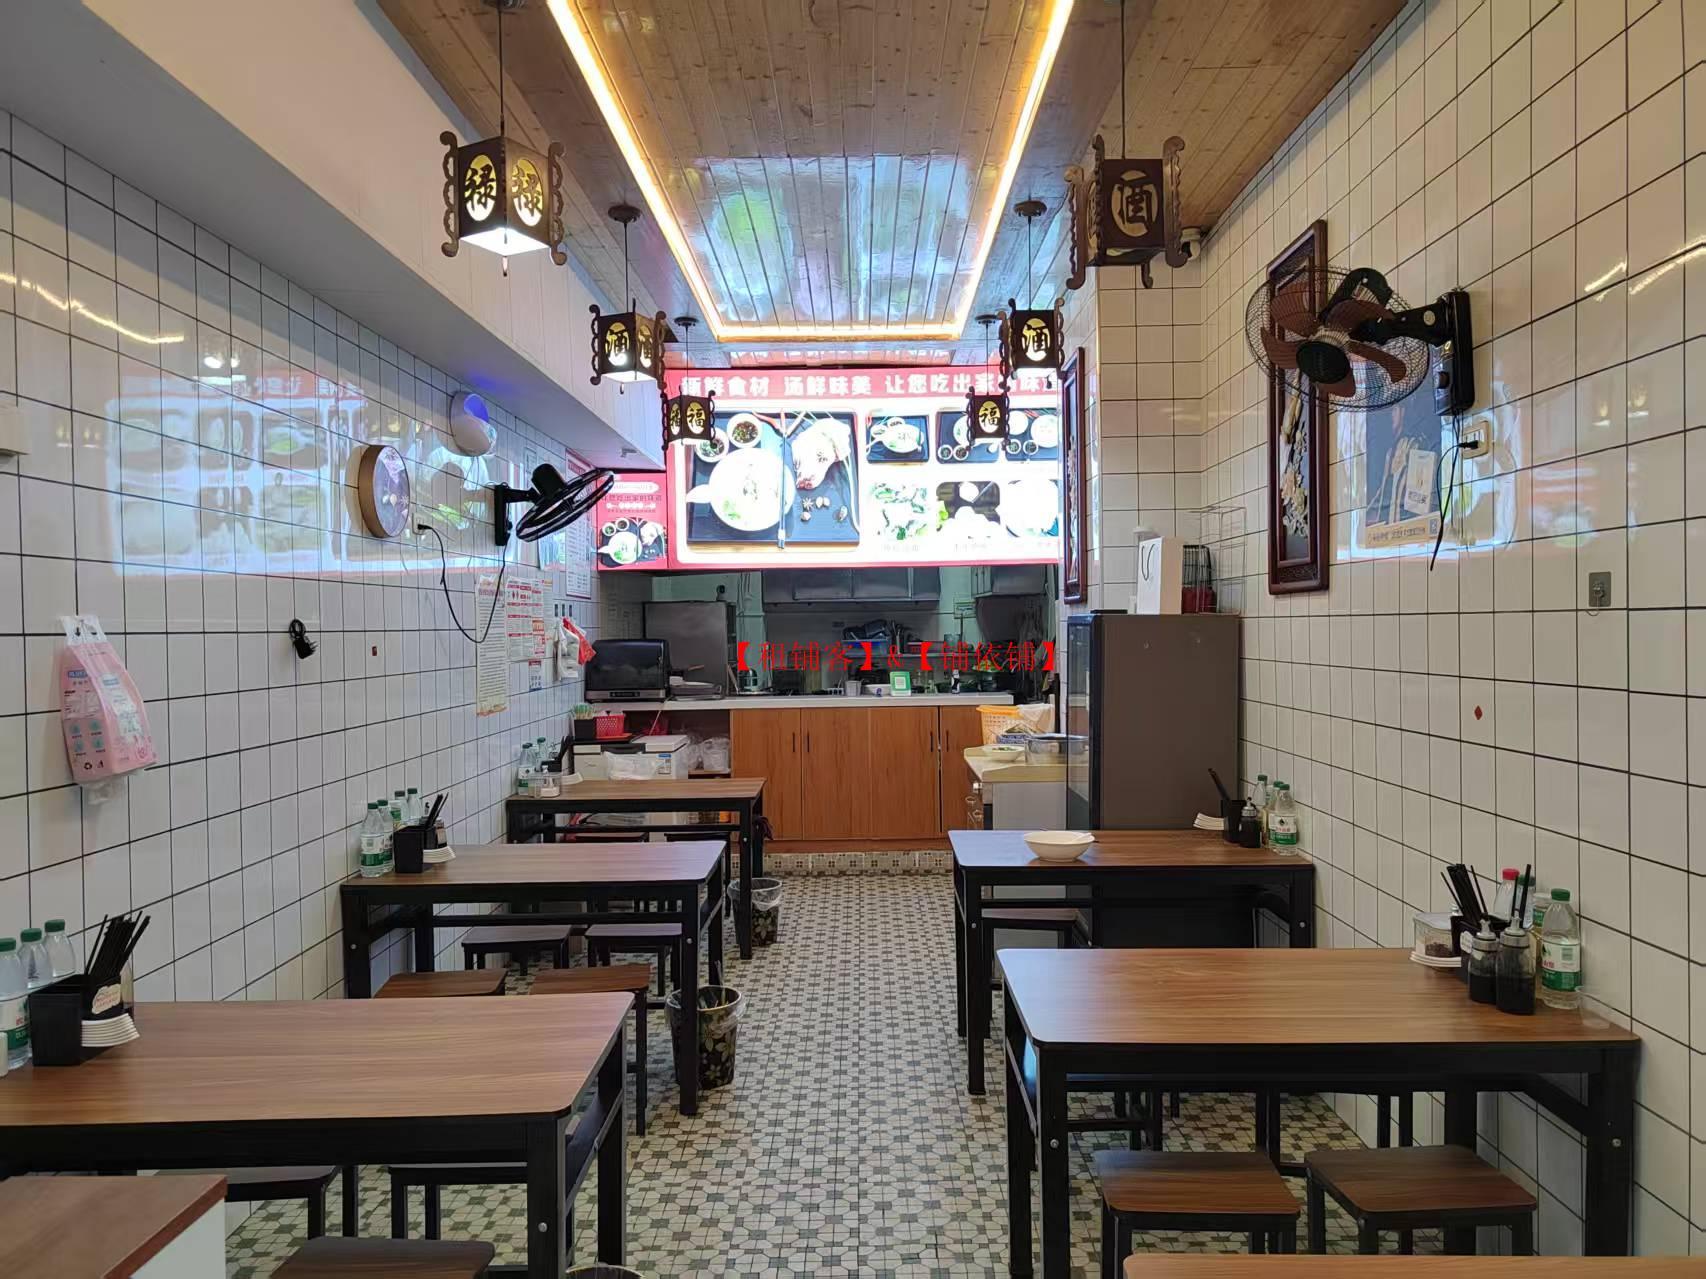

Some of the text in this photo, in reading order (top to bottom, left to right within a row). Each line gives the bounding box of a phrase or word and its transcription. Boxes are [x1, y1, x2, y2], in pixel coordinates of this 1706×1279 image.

[783, 375, 873, 396] 汤鲜味美
[687, 407, 705, 428] 福
[979, 406, 1001, 427] 福
